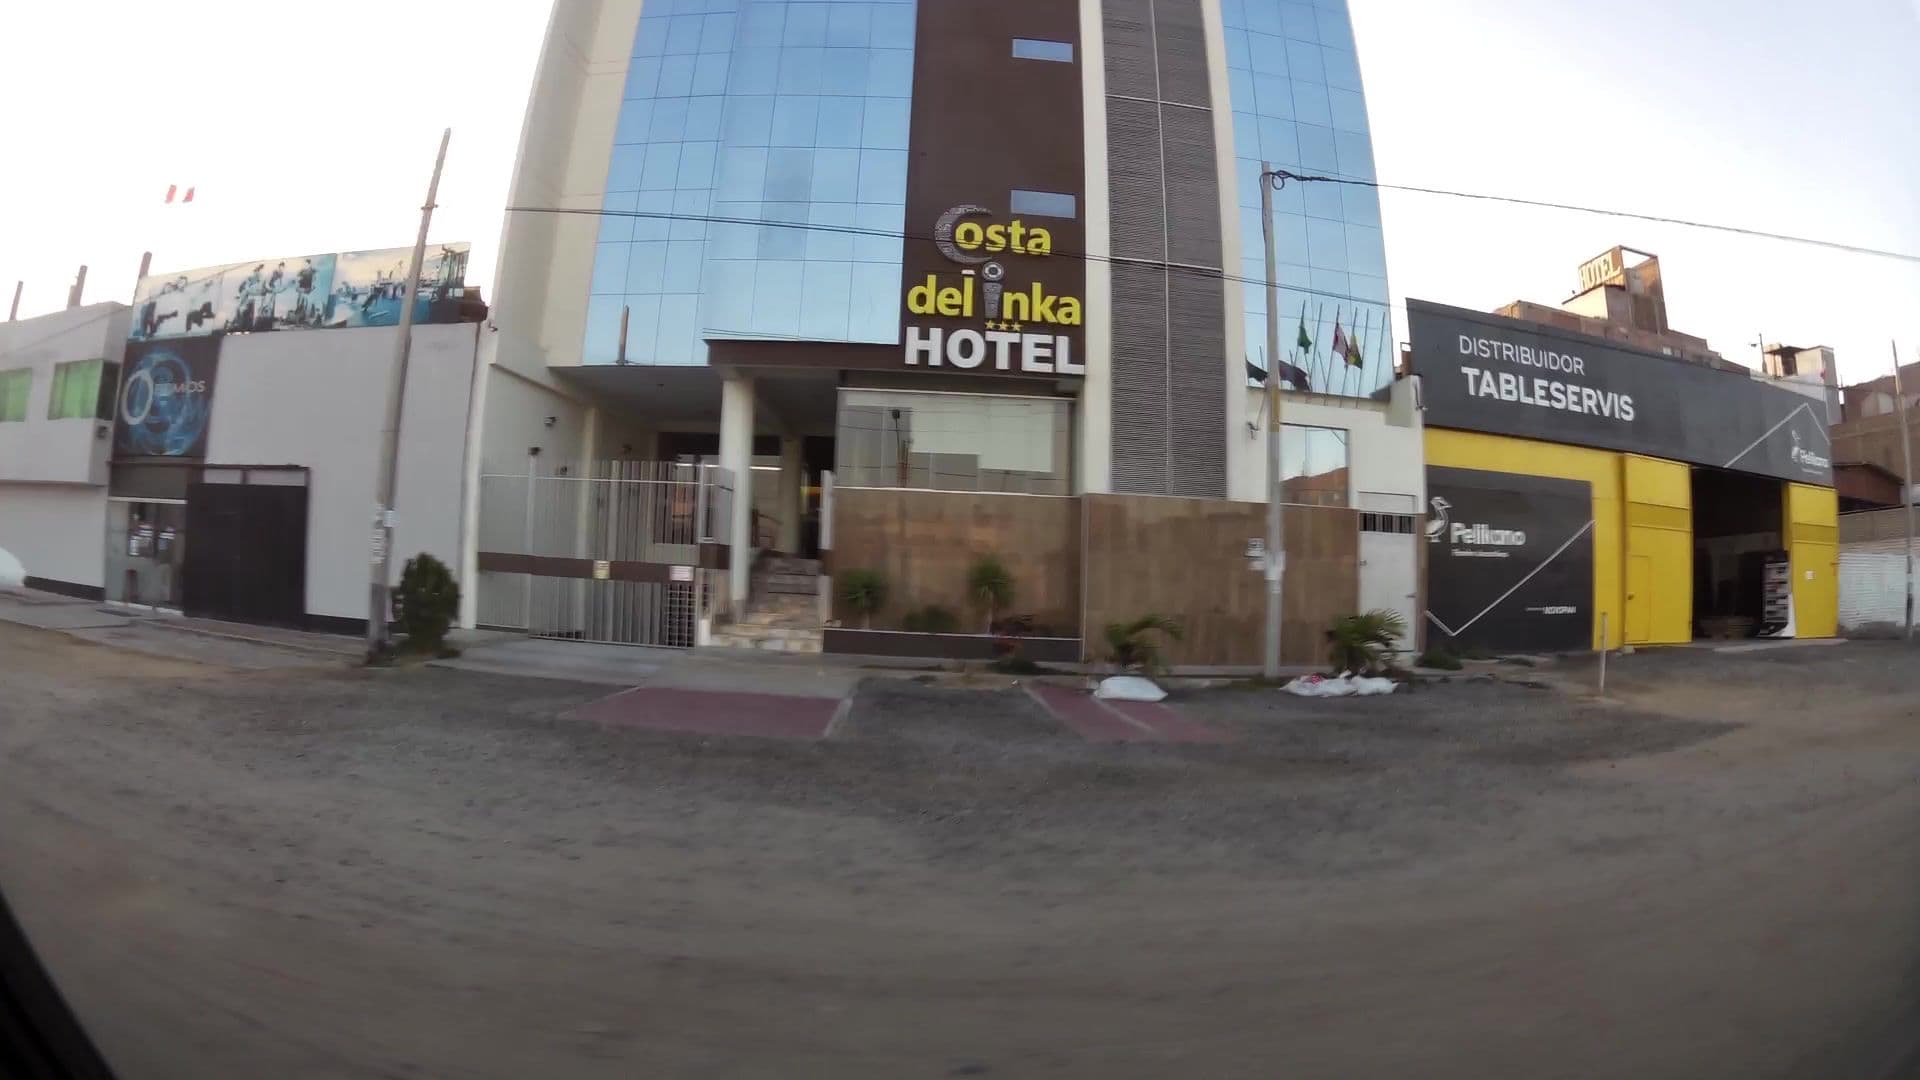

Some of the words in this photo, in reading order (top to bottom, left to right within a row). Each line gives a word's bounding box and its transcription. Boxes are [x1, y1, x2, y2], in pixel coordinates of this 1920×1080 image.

[934, 204, 1051, 263] Costa
[907, 270, 974, 317] del
[1578, 251, 1621, 291] HOTEL
[904, 326, 1085, 375] HOTEL
[1459, 335, 1585, 376] DISTRIBUIDOR
[1461, 366, 1636, 422] TABLESERVIS
